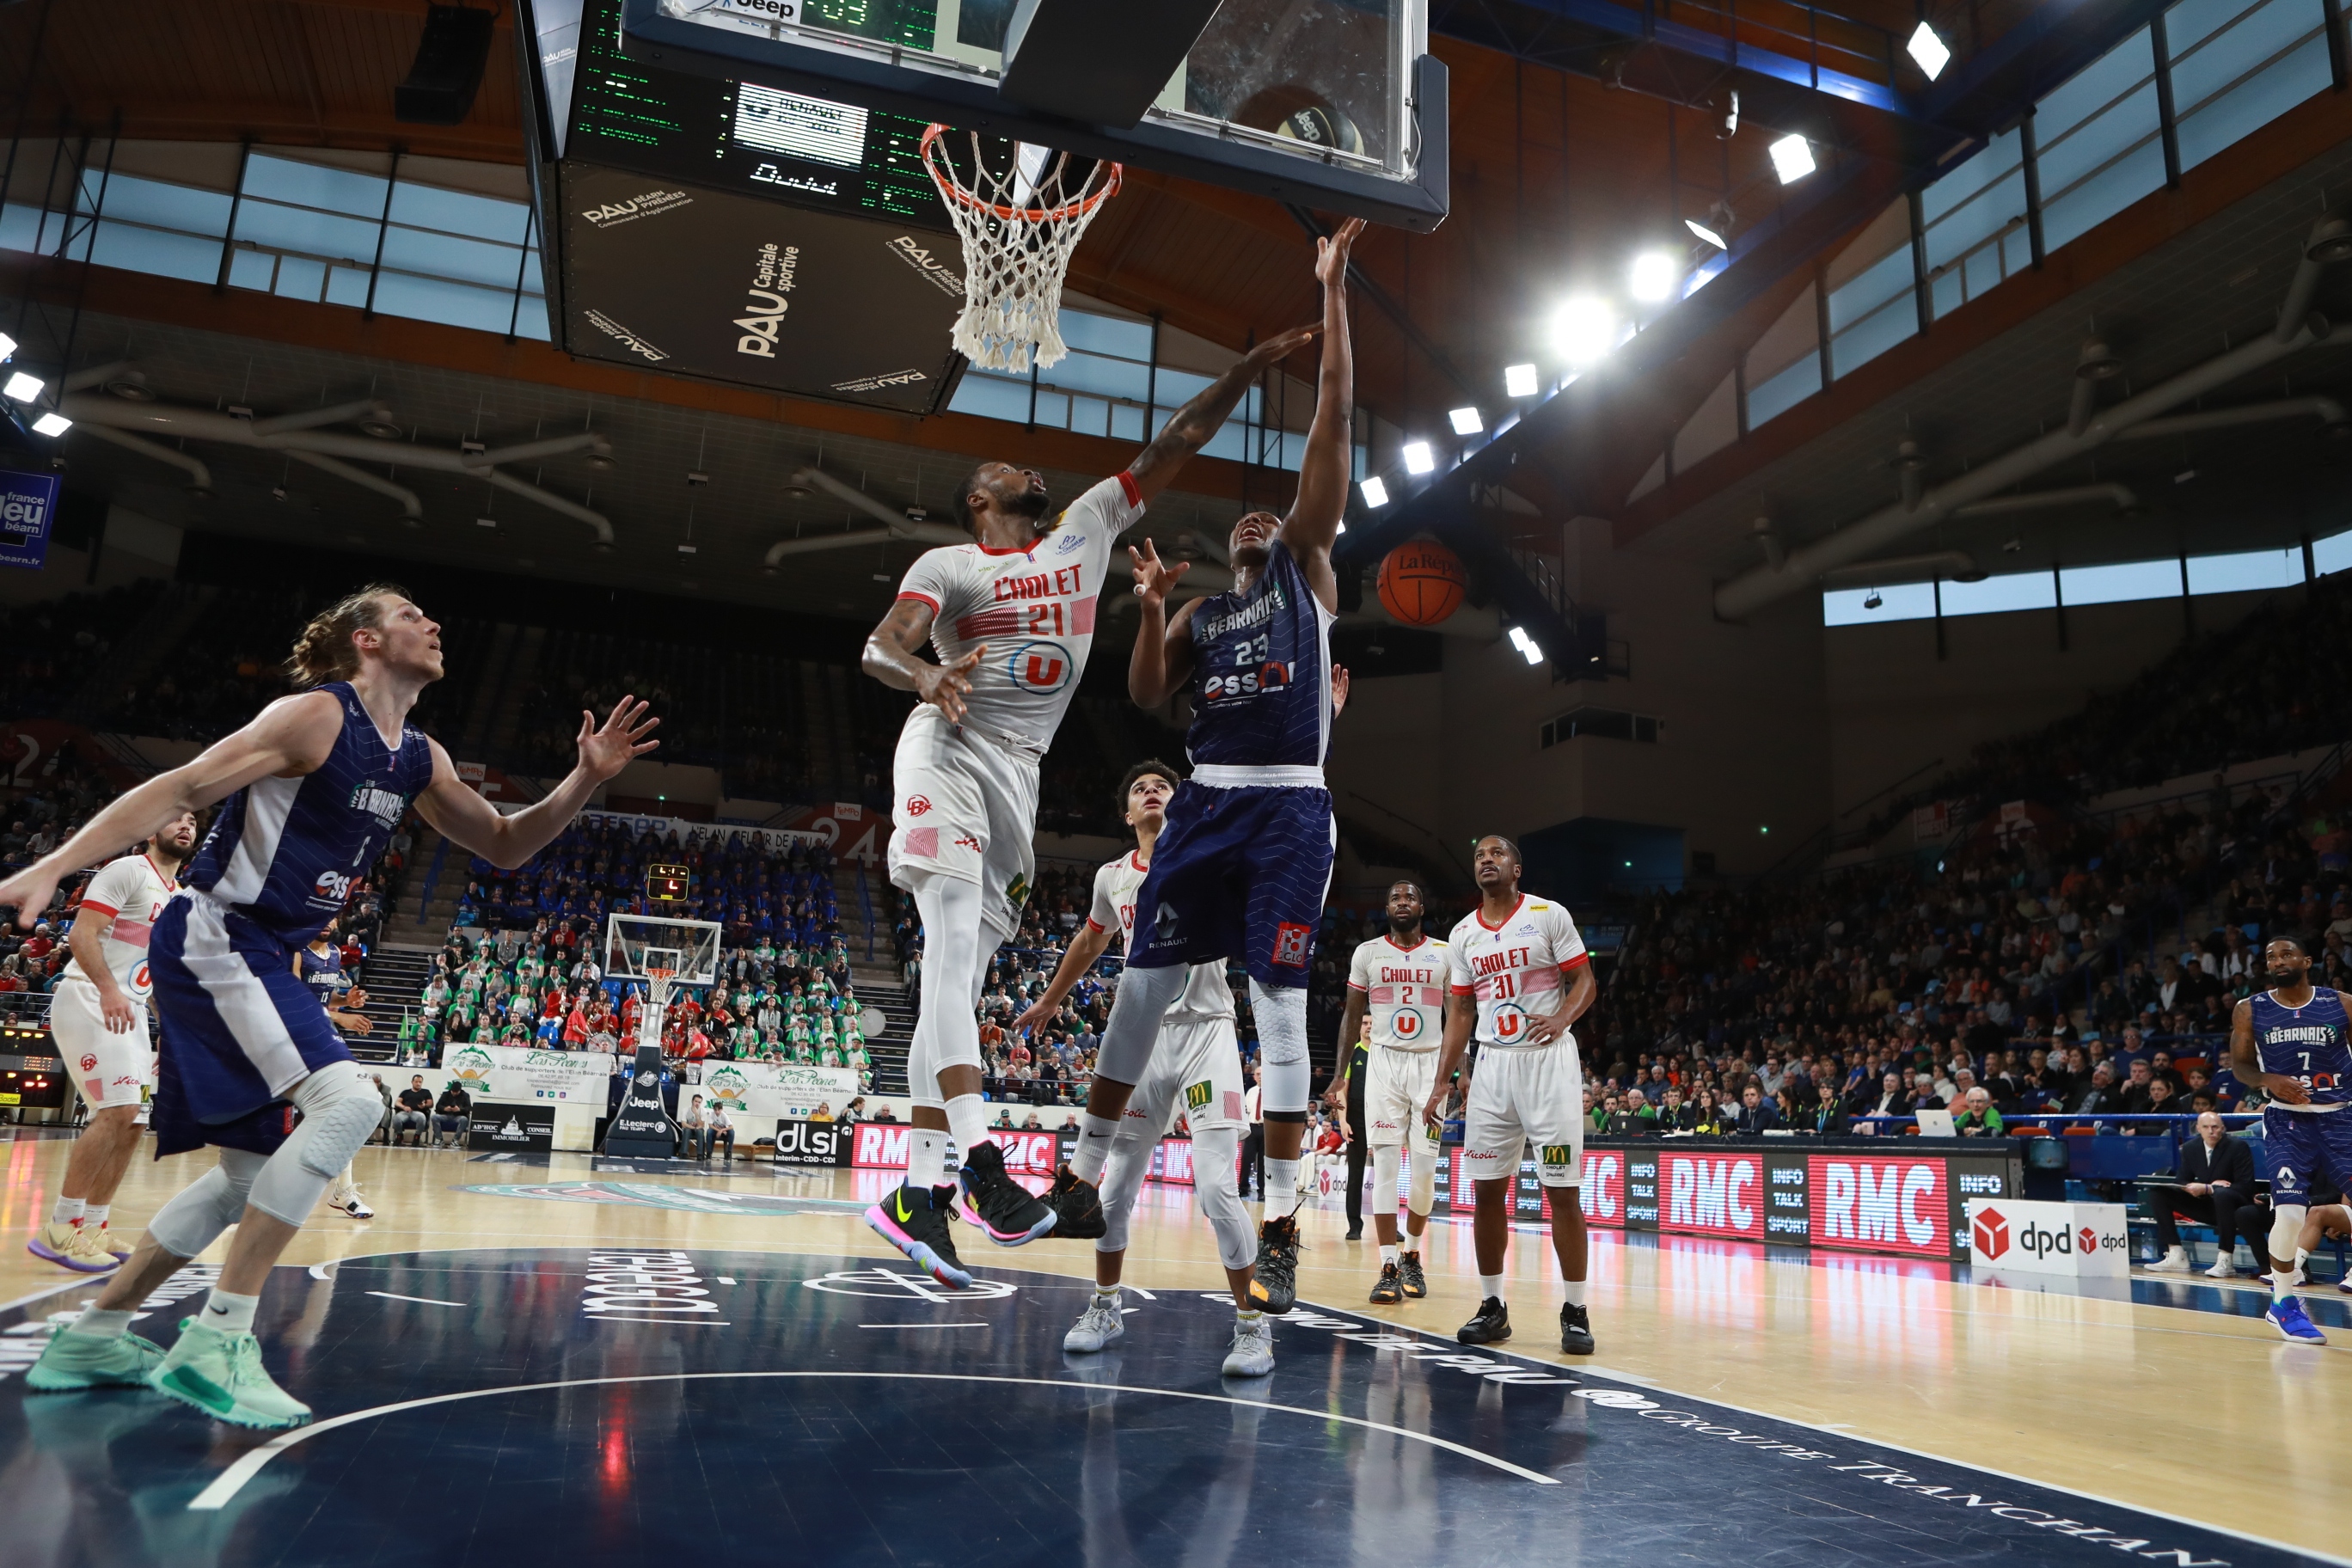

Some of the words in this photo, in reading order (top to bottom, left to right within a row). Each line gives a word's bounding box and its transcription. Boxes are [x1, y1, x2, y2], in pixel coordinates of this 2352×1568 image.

[1295, 110, 1321, 141] Jeep
[582, 200, 639, 223] PAU
[597, 214, 640, 229] Communauté
[885, 241, 918, 268] Communauté
[893, 236, 945, 270] PAU
[753, 243, 779, 288] Capitale
[777, 246, 799, 292] sportive
[732, 289, 788, 358] PAU
[615, 335, 665, 361] PAU
[877, 371, 928, 388] PAU
[7, 492, 45, 505] france
[4, 521, 40, 534] béarn
[1399, 554, 1418, 570] La
[994, 563, 1081, 602] CHOLET
[1028, 603, 1063, 636] 21
[1234, 634, 1269, 666] 23
[776, 834, 789, 848] DE
[1148, 937, 1189, 949] RENAULT
[1472, 947, 1530, 977] CHOLET
[1381, 966, 1433, 984] CHOLET
[1401, 986, 1412, 1004] 2
[1494, 974, 1515, 1000] 31
[2270, 1026, 2327, 1044] BEARNAIS
[2298, 1052, 2310, 1070] 7
[629, 1097, 658, 1110] Jeep
[619, 1119, 655, 1128] E.Leclerc
[776, 1124, 838, 1155] dlsi
[859, 1127, 910, 1165] RM
[1631, 1162, 1656, 1178] INFO
[1772, 1168, 1804, 1185] INFO
[1364, 1179, 1374, 1191] dp
[1579, 1155, 1618, 1218] MC
[1631, 1184, 1655, 1197] TALK
[1669, 1158, 1755, 1230] RMC
[1959, 1174, 2002, 1194] INFO
[1773, 1191, 1804, 1208] TALK
[1824, 1162, 1936, 1246] RMC
[1626, 1205, 1659, 1222] SPORT
[1767, 1216, 1809, 1234] SPORT
[2020, 1221, 2072, 1259] dpd
[2102, 1232, 2126, 1253] dpd
[1332, 1333, 1451, 1351] DE
[1408, 1355, 1583, 1385] PAU
[1637, 1409, 1837, 1461] GROUPE
[1827, 1460, 2233, 1568] TRANCHAN
